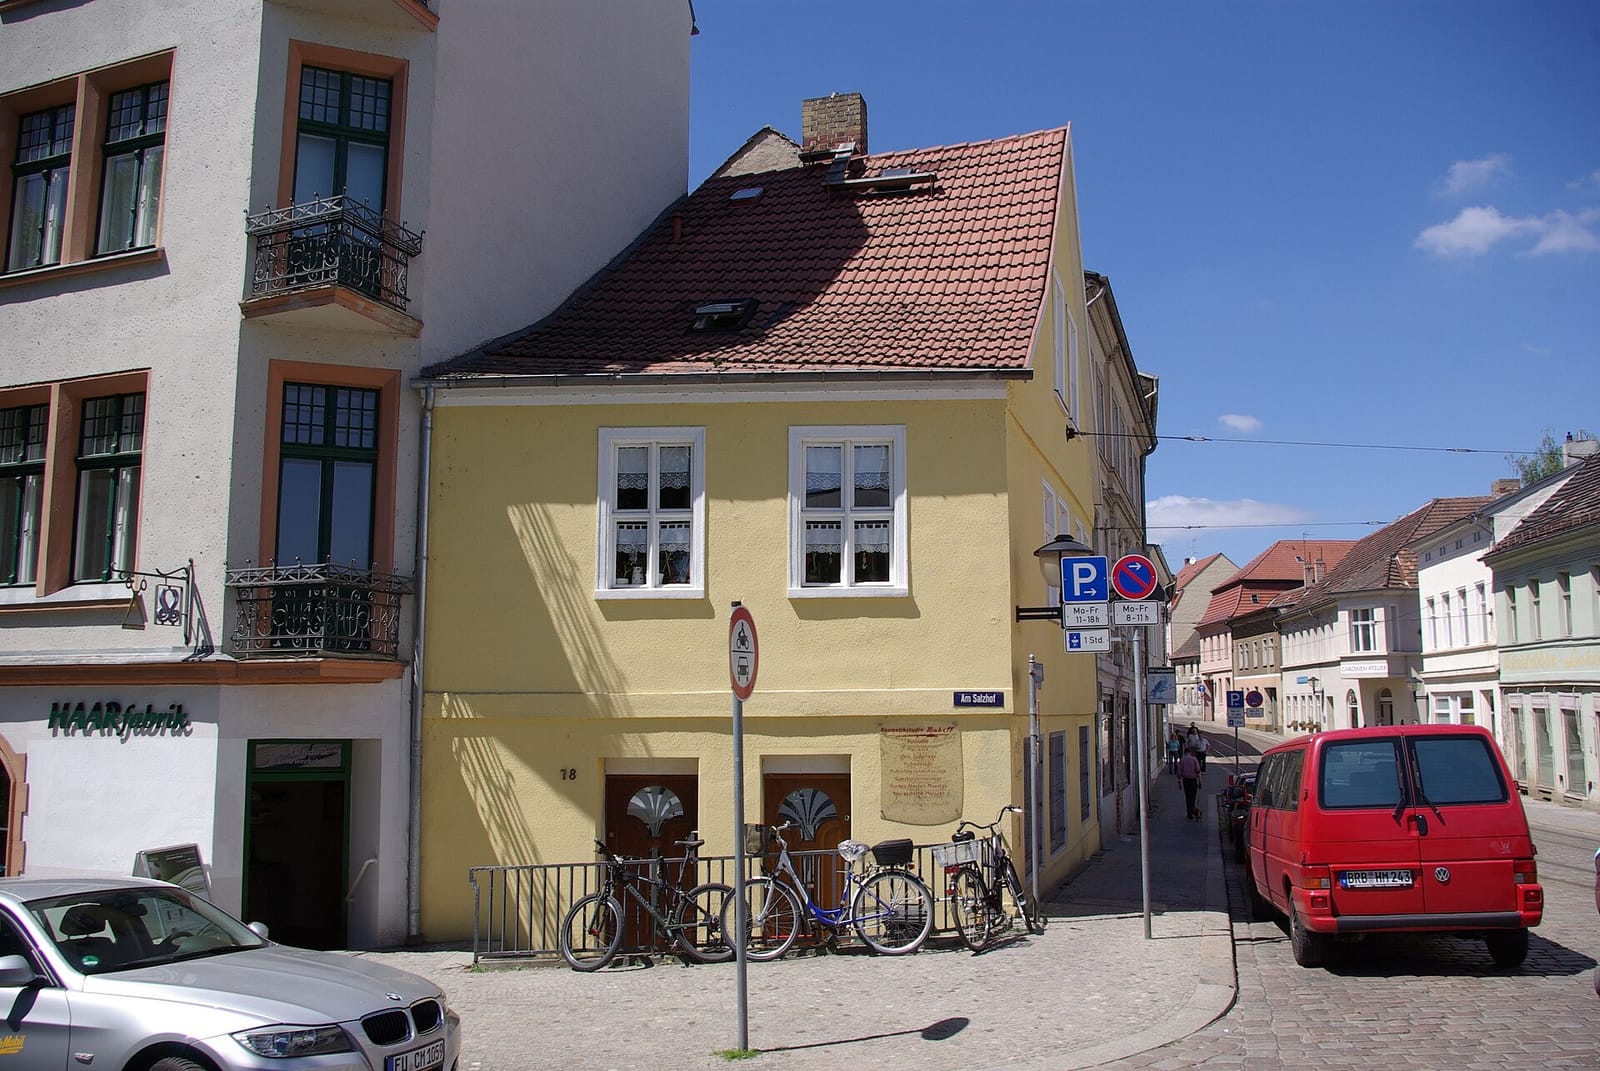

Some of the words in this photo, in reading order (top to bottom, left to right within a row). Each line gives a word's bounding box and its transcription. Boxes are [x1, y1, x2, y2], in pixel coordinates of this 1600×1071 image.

[1073, 563, 1097, 596] P
[1122, 605, 1149, 613] Mo-Fr
[960, 693, 971, 703] Am
[972, 693, 996, 703] Salzhof
[559, 768, 577, 781] 78
[1347, 872, 1368, 884] BRB
[1390, 871, 1411, 883] 243
